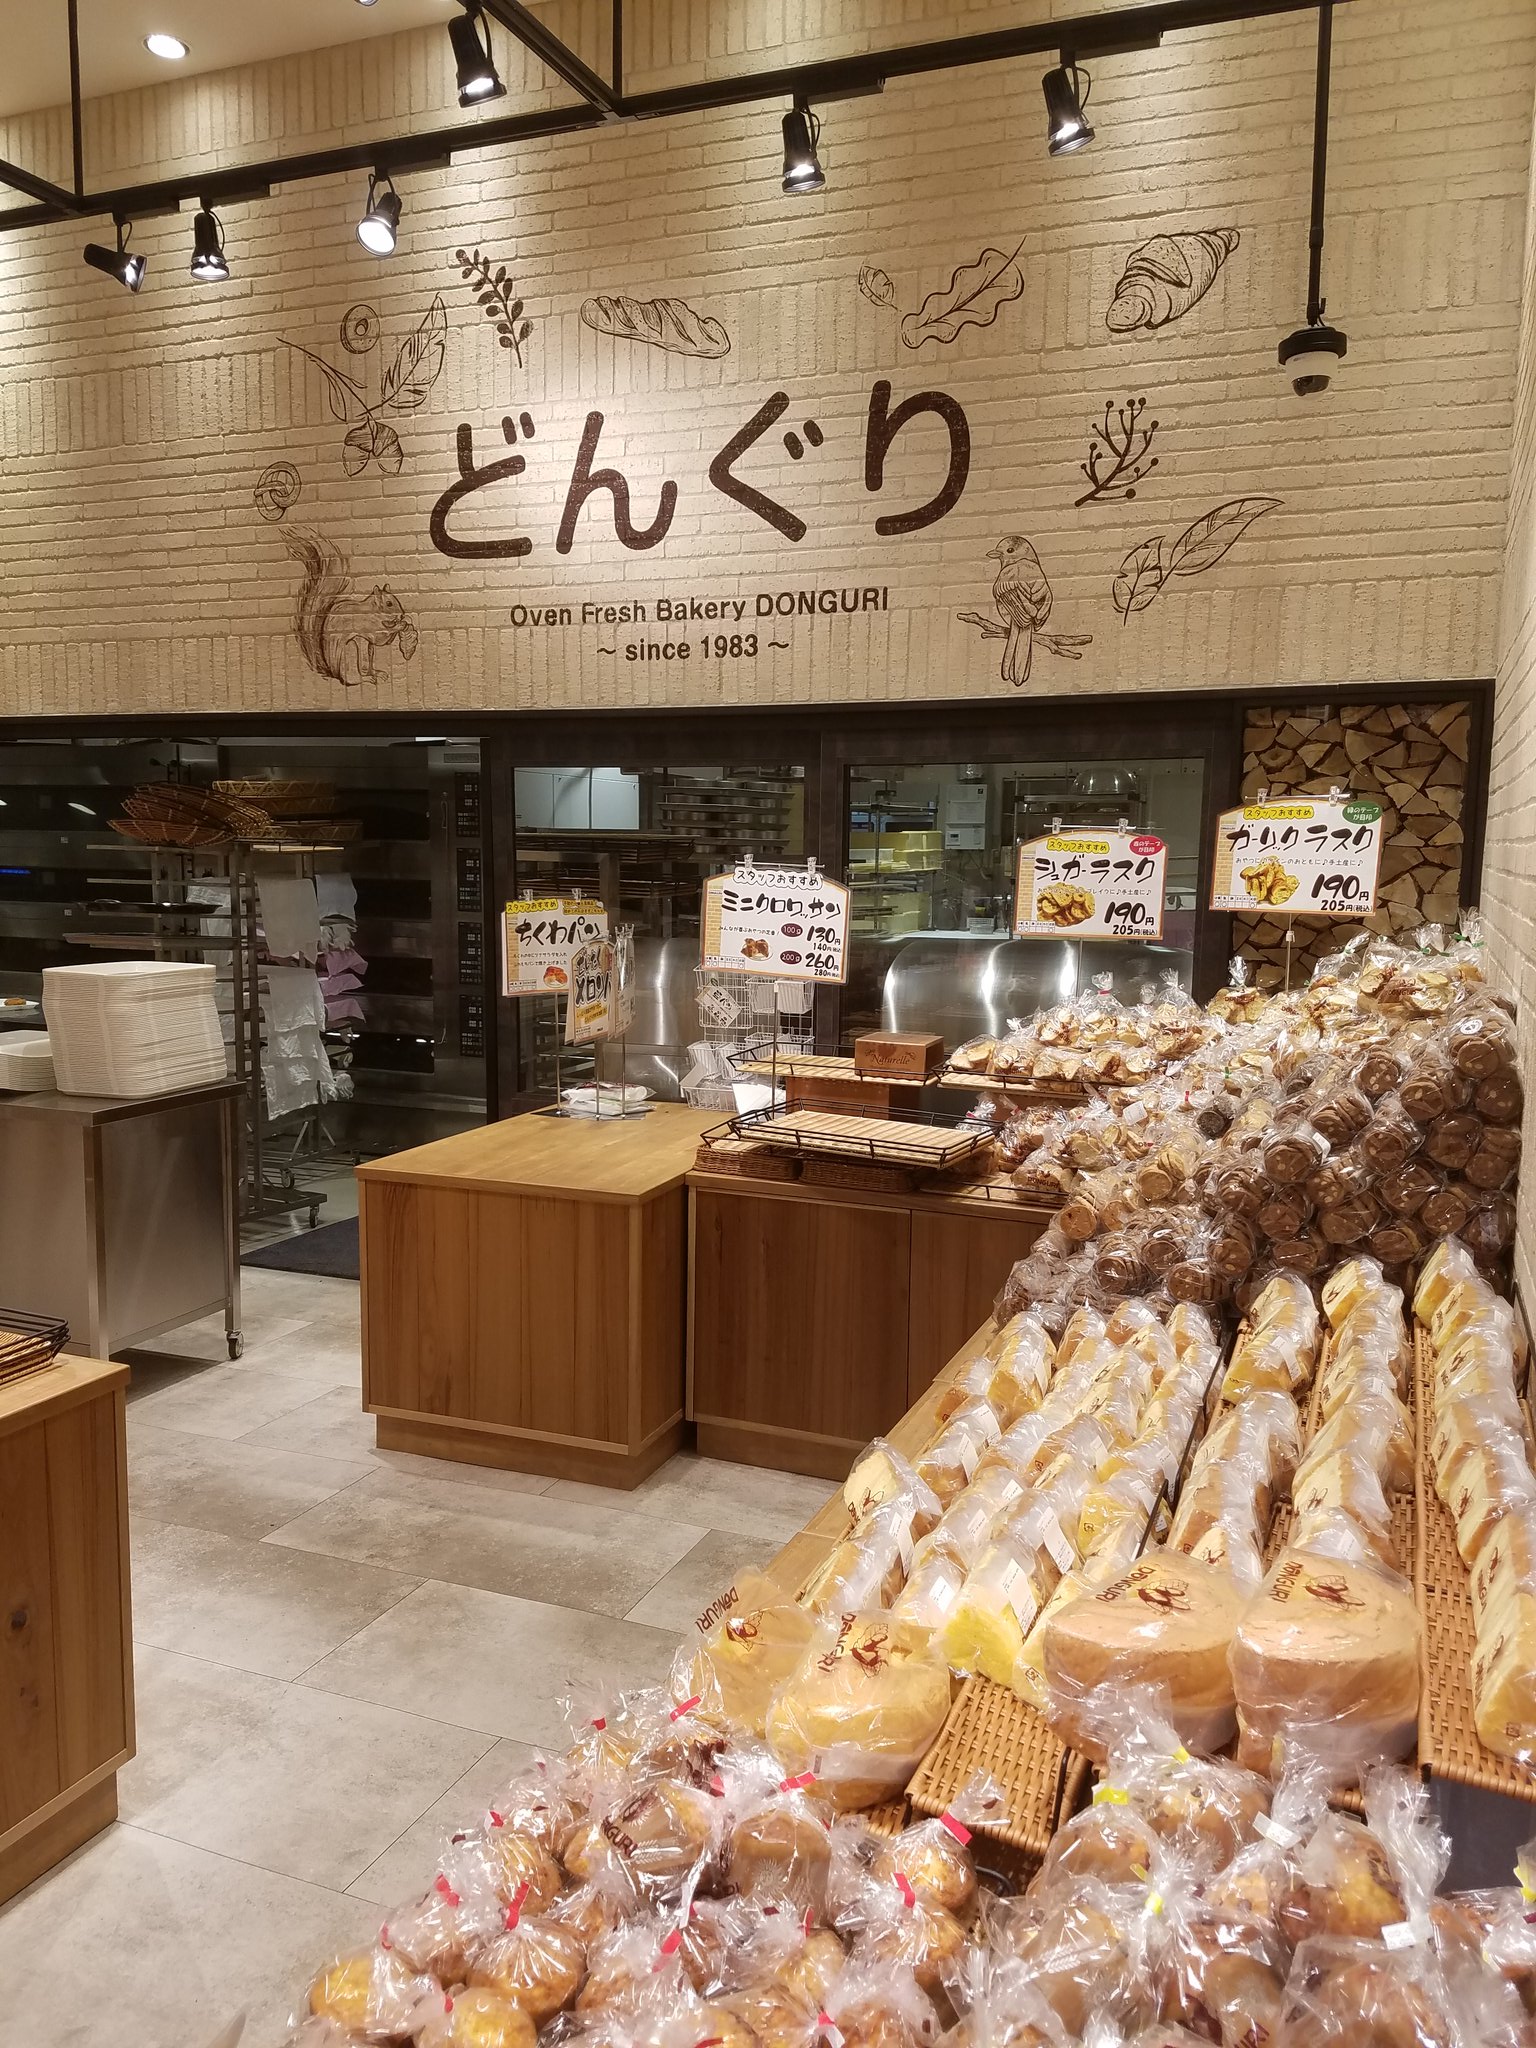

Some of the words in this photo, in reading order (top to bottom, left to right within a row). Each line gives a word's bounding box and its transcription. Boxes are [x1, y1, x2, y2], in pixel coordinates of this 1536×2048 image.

[429, 380, 971, 559] どんぐり
[510, 604, 572, 627] Oven
[581, 601, 646, 625] Fresh
[656, 598, 746, 624] Bakery
[756, 587, 888, 618] DONGURI
[625, 638, 691, 660] since
[701, 634, 759, 660] 1983
[1246, 808, 1312, 819] スタッフおすすめ
[1048, 839, 1107, 851] スタッフおすすめ
[737, 870, 819, 886] スタッフおすすめ
[1034, 854, 1155, 883] シュガーラスク
[507, 901, 557, 911] スタッフおすすめ
[721, 889, 841, 920] ミニクロワッサン
[515, 916, 600, 946] ちくわパン
[871, 1053, 910, 1065] Naturelle
[1096, 1566, 1157, 1602] DONGURI
[1269, 1561, 1304, 1604] DONGURI
